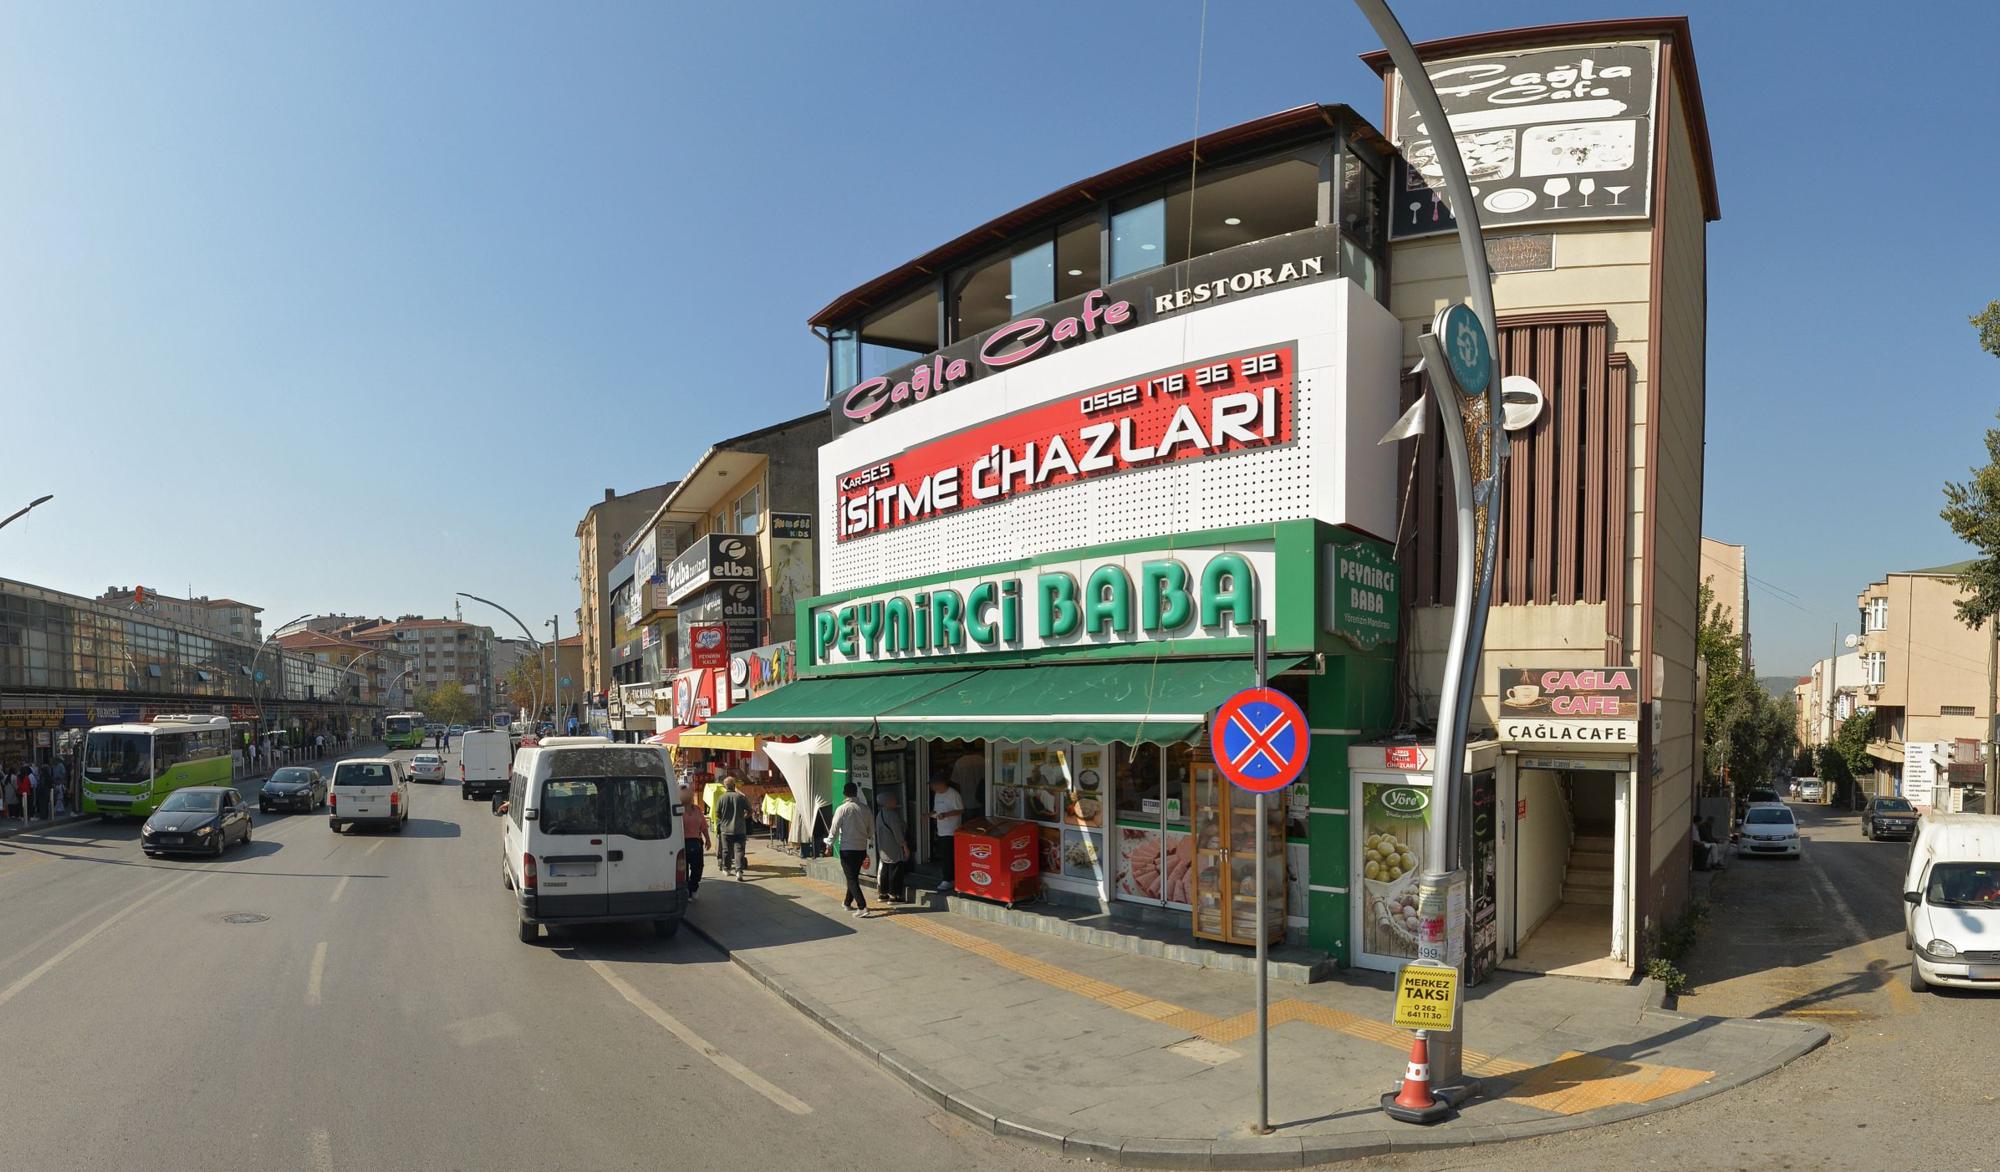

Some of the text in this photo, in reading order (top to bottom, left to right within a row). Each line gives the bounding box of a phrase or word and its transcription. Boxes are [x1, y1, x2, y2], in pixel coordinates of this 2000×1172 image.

[1487, 80, 1610, 104] Cafe
[843, 256, 1323, 422] Çağla Cafe RESTORAN
[1080, 353, 1277, 415] 0552 176 36 36
[971, 386, 1276, 500] CİHAZLARI
[712, 561, 754, 577] elba
[1038, 552, 1262, 640] BABA
[1350, 587, 1384, 614] BABA
[724, 602, 756, 615] elba
[1551, 695, 1620, 715] CAFE
[1508, 723, 1627, 741] ÇAĞLA CAFE
[1405, 977, 1450, 989] MERKEZ
